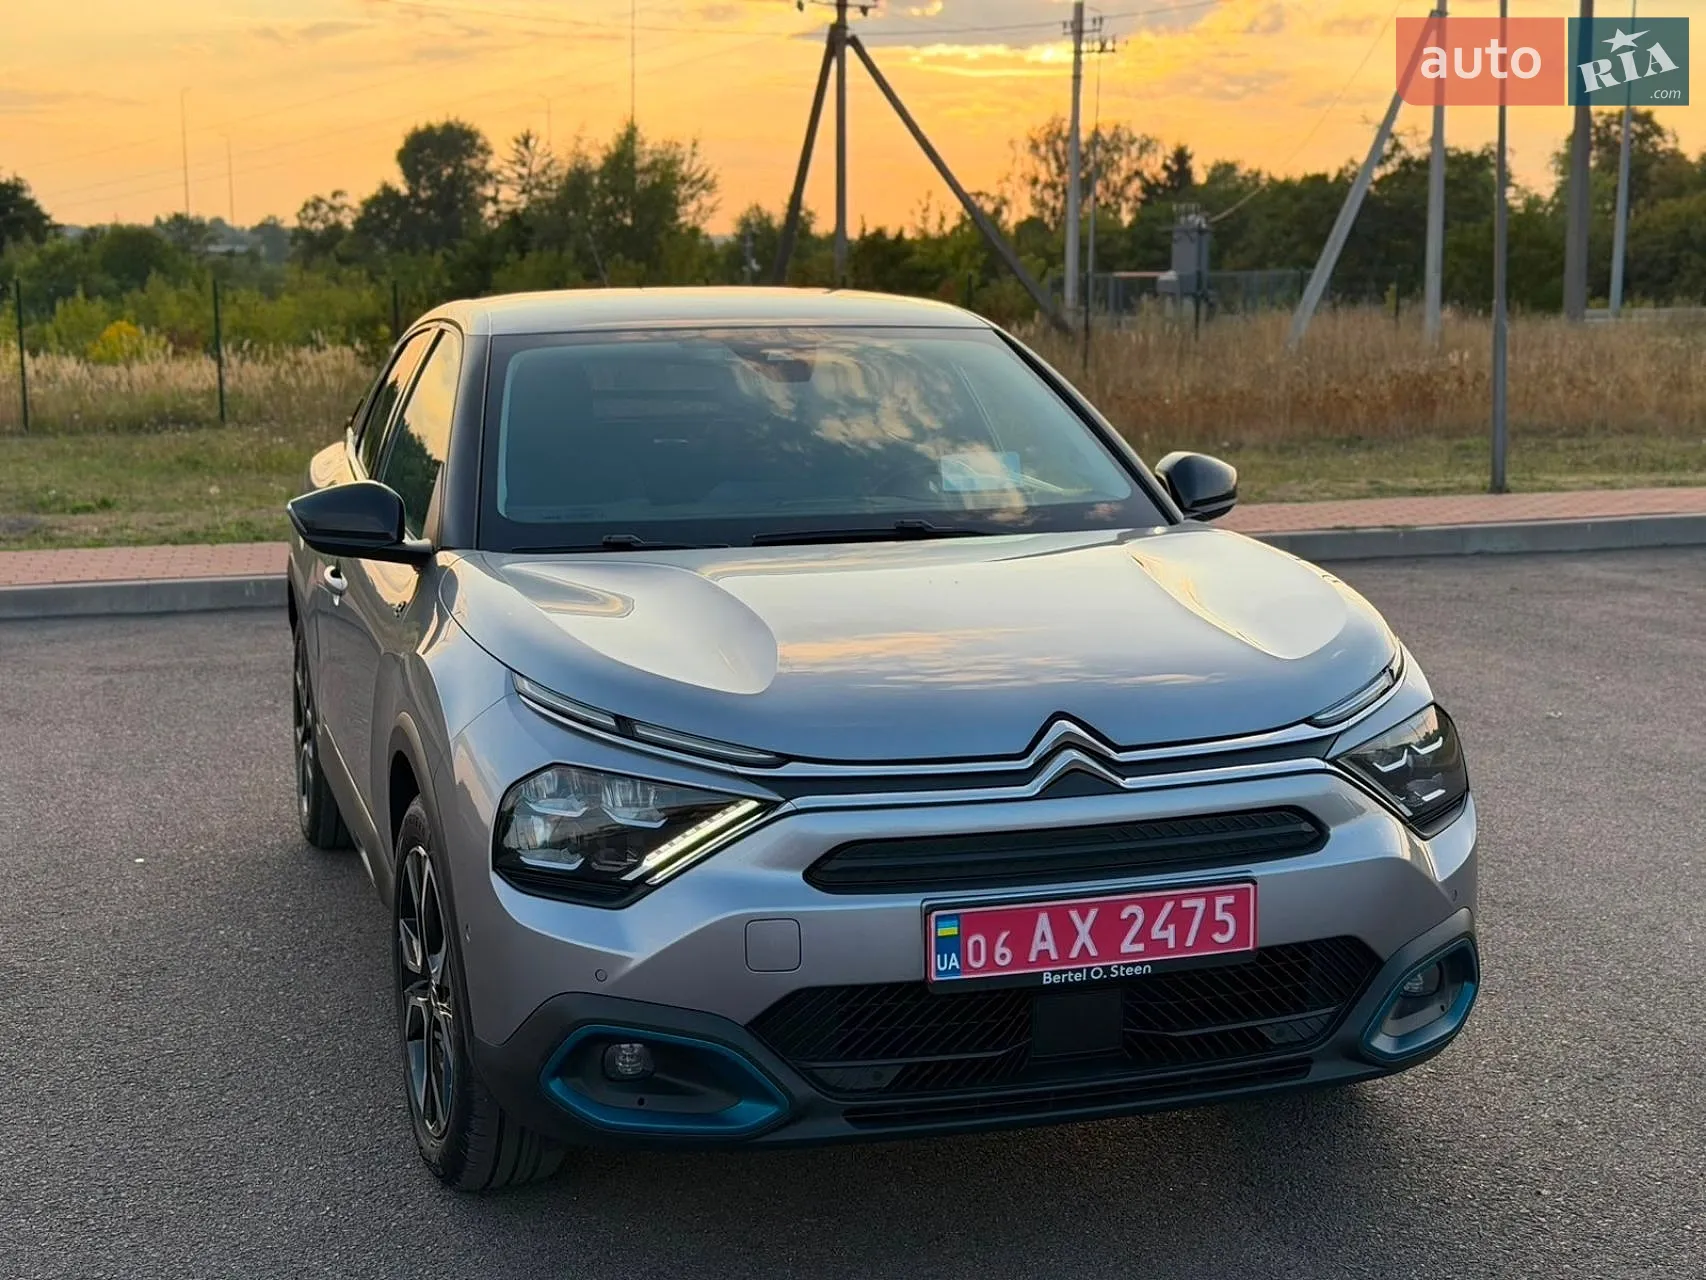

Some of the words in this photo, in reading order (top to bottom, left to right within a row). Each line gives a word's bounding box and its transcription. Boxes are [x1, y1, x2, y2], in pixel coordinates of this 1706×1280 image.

[967, 930, 1013, 969] 06
[1028, 908, 1099, 962] AX
[1119, 896, 1237, 954] 2475
[936, 952, 961, 972] UA
[1042, 967, 1087, 985] Bertel
[1090, 966, 1108, 980] O.
[1110, 962, 1152, 977] Steen
